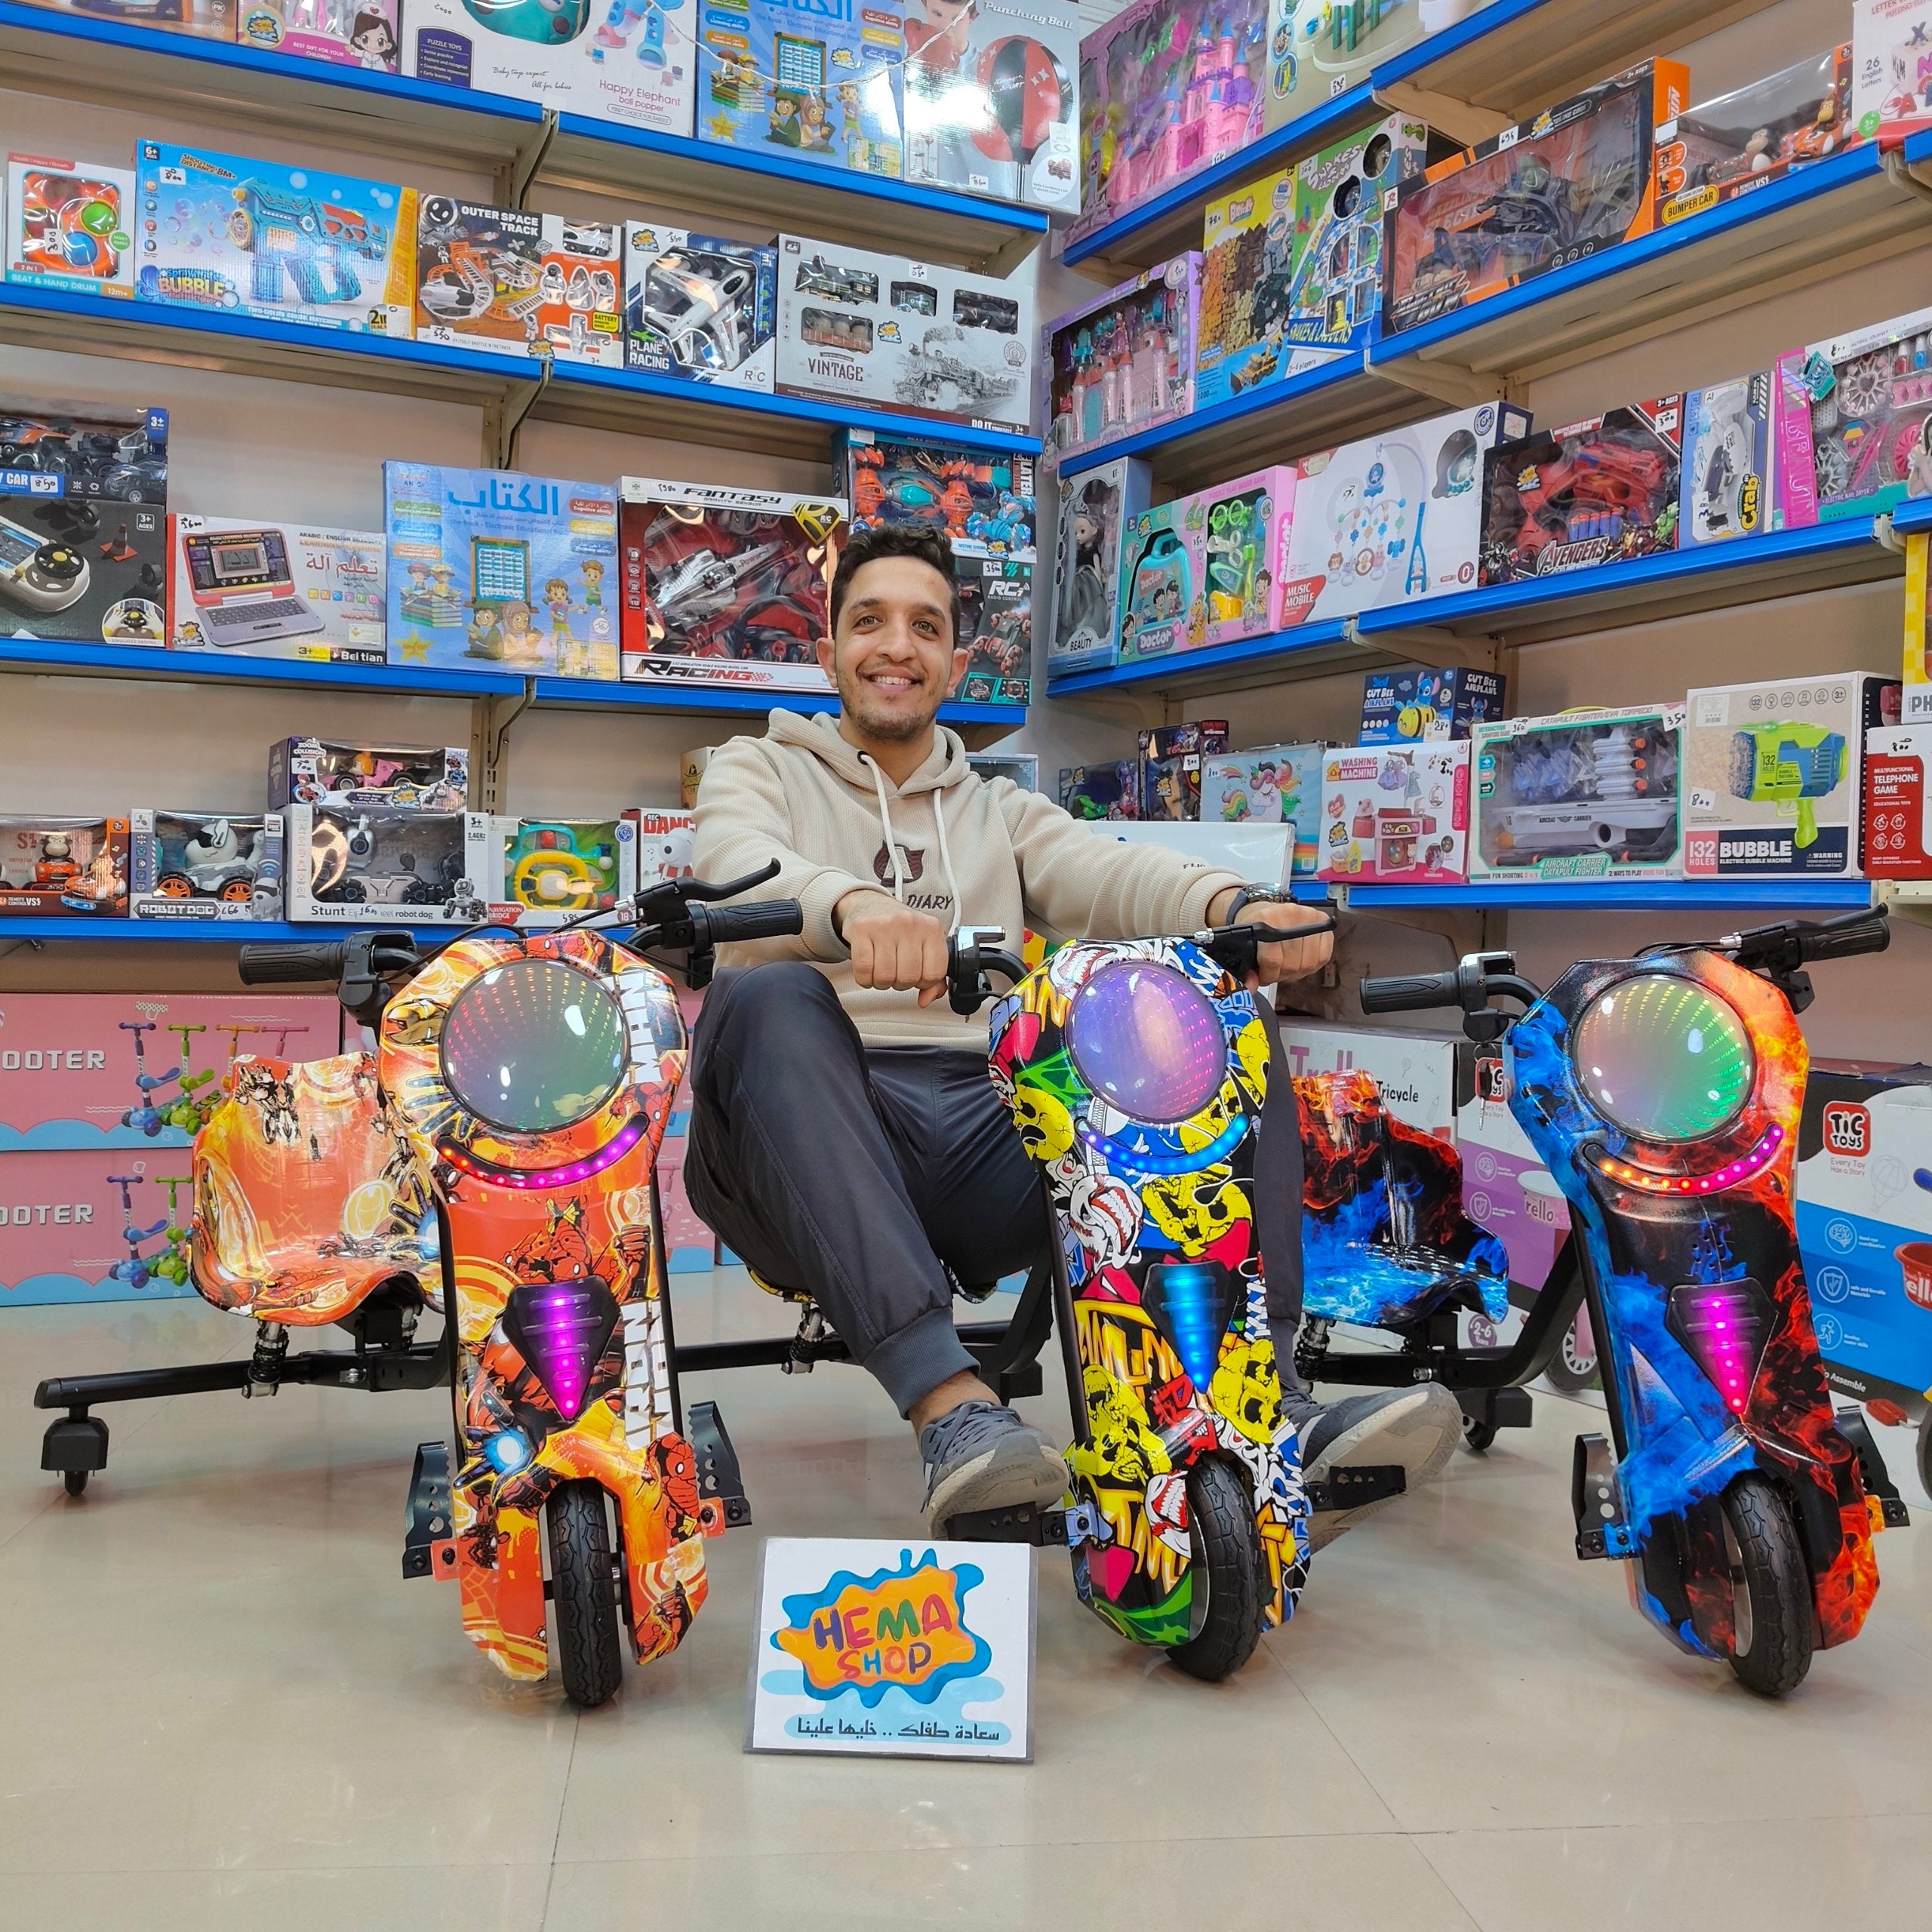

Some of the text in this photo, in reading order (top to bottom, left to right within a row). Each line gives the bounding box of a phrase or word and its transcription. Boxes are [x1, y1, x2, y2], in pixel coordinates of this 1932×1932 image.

[985, 2, 1074, 30] Punching Ball
[427, 38, 463, 51] PUZZLE TOYS
[1866, 57, 1880, 71] 26
[1861, 68, 1883, 81] English
[1861, 77, 1881, 89] Letters
[599, 79, 681, 106] Happy Elephant
[619, 95, 664, 112] ball popper
[145, 146, 158, 155] 6+
[180, 160, 217, 174] DISTANCE
[1668, 198, 1698, 217] BUMPER
[1699, 192, 1715, 206] CAR
[461, 205, 539, 226] OUTER SPACE
[500, 222, 539, 236] TRACK
[11, 272, 97, 292] BEAT & HAND DRUM
[158, 276, 226, 300] BUBBLE
[107, 287, 129, 297] 12m+
[594, 314, 618, 323] BATTERY
[630, 339, 663, 356] PLANE
[629, 352, 670, 370] RACING
[1298, 359, 1317, 372] players
[808, 357, 864, 383] VINTAGE
[150, 417, 164, 426] 3+
[971, 419, 992, 430] DO IT
[7, 472, 28, 485] CAR
[448, 479, 559, 515] الكتاب
[1740, 475, 1760, 531] Crab
[1825, 493, 1846, 504] ELECTRIC
[140, 515, 152, 523] 3+
[1538, 537, 1610, 574] AVENGERS
[336, 555, 379, 578] تعلم
[1287, 582, 1312, 596] MUSIC
[1285, 591, 1315, 608] MOBILE
[297, 646, 314, 656] 3+
[1069, 638, 1093, 651] BEAUTY
[341, 650, 383, 663] Bei tian
[634, 658, 755, 682] RACING
[1464, 682, 1498, 696] AIRPLANE
[1364, 697, 1395, 709] AIRPLANE
[293, 747, 325, 757] COLLISION
[297, 741, 318, 750] ZOOM
[1340, 756, 1378, 768] WASHING
[1762, 755, 1776, 765] 132
[1340, 766, 1378, 780] MACHINE
[1874, 774, 1919, 785] TELEPHONE
[1874, 785, 1898, 795] GAME
[471, 816, 483, 826] 3+
[1689, 840, 1716, 858] 132
[1719, 840, 1793, 859] BUBBLE
[1813, 851, 1843, 860] WARNING
[1545, 857, 1607, 869] AIRCRAFT CARRIER
[1689, 857, 1716, 866] HOLES
[1543, 867, 1604, 877] CATAPULT FIGHTER
[906, 894, 954, 910] DIARY
[139, 904, 215, 916] ROBOT DOG
[311, 905, 433, 920] Stunt robot dog
[1376, 1080, 1419, 1103] Tricycle
[1830, 1157, 1866, 1169] Every Toy
[1849, 1168, 1866, 1177] Story
[1472, 1323, 1494, 1337] 2-6
[1830, 1372, 1867, 1394] Assemble
[813, 1593, 952, 1653] HEMA
[836, 1641, 933, 1680] SHOP
[797, 1715, 1001, 1741] سعادة طفلك خليها علينا
